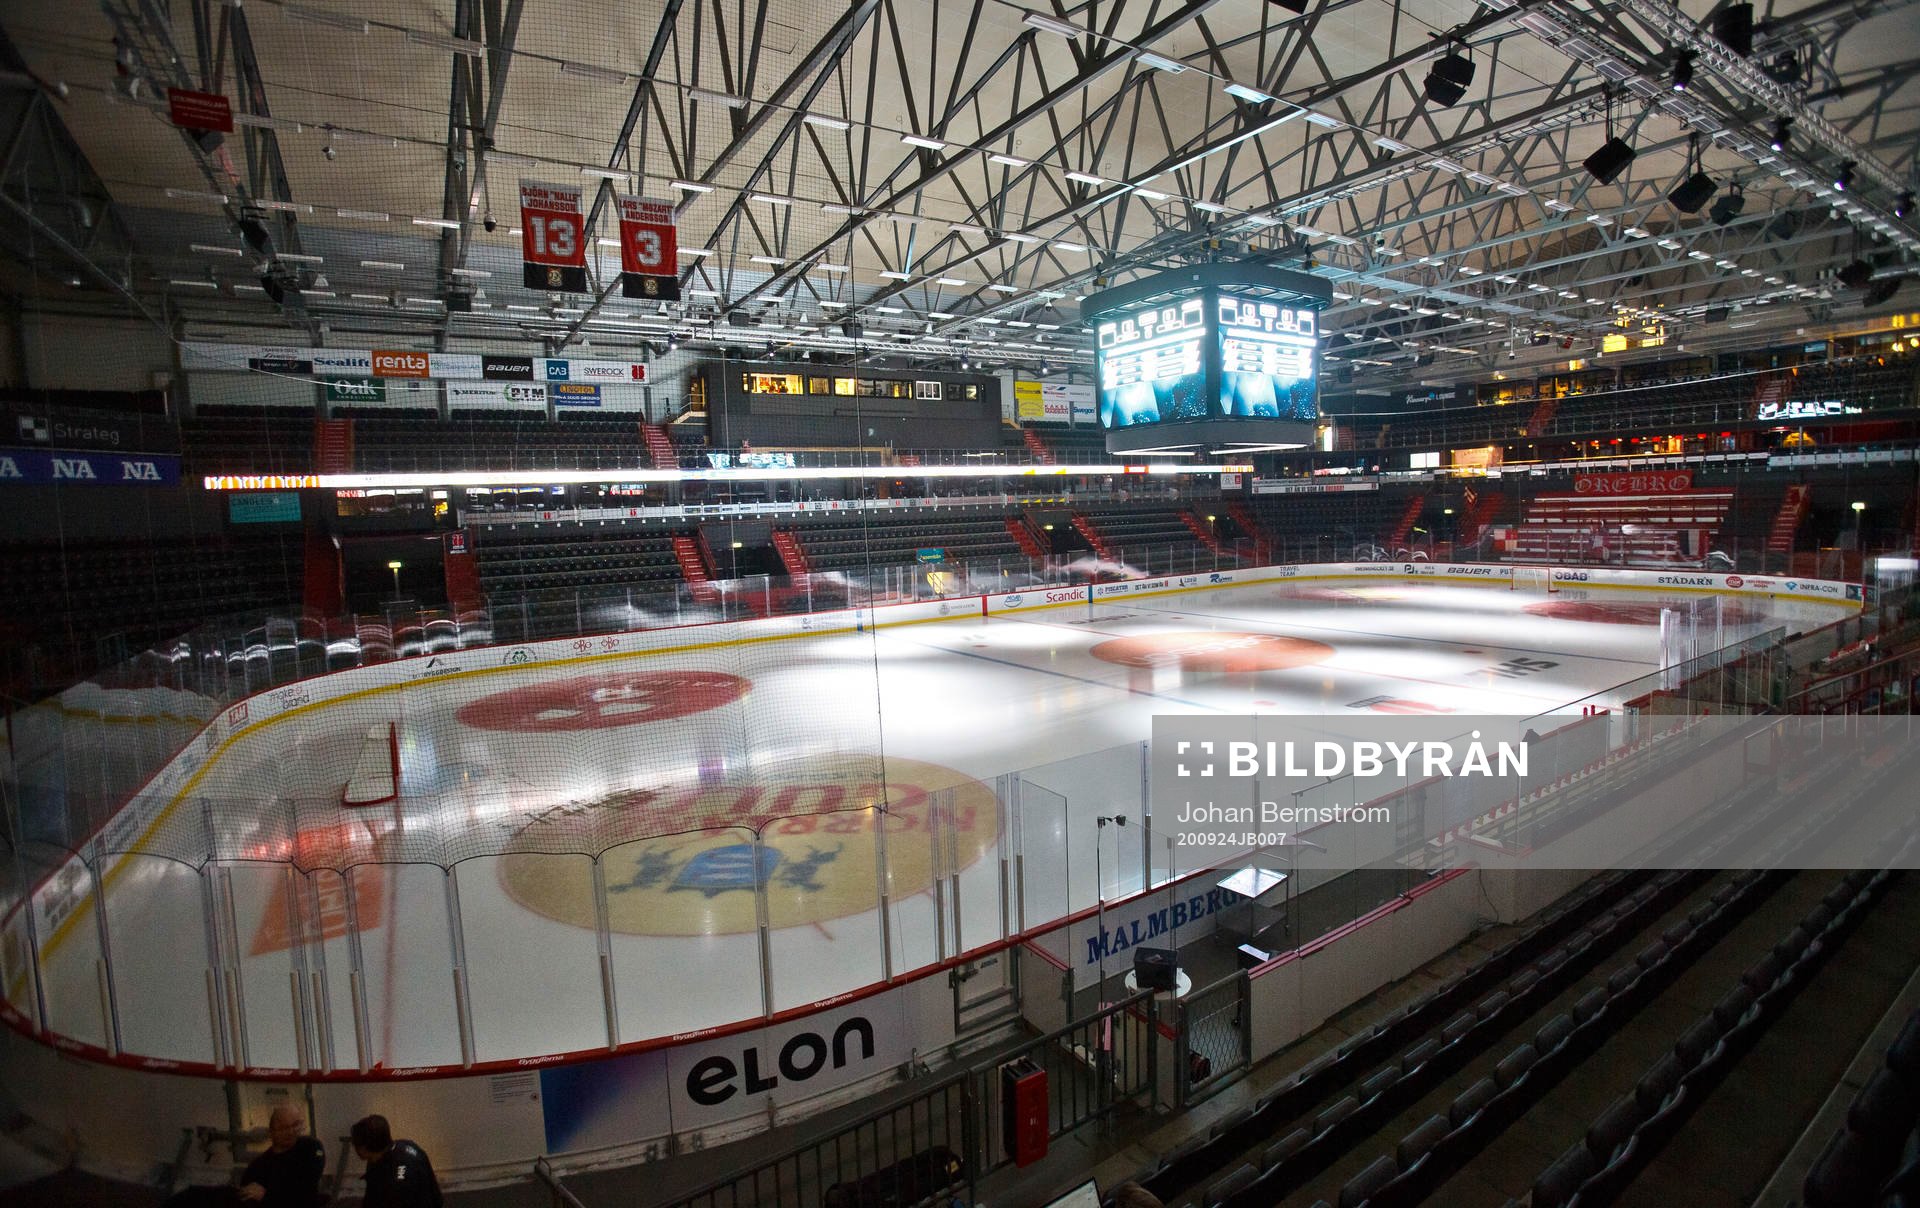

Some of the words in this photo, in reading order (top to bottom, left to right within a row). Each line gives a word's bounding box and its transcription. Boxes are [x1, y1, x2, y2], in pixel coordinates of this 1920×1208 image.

[530, 216, 576, 256] 13
[636, 229, 662, 266] 3
[314, 356, 372, 368] Sealift
[375, 354, 426, 370] renta
[584, 367, 625, 376] SWEROCK
[334, 379, 377, 396] Oak
[55, 422, 120, 446] Strateg
[0, 456, 23, 478] A
[52, 458, 97, 479] NA
[121, 460, 162, 481] NA
[1046, 589, 1084, 603] Scandic
